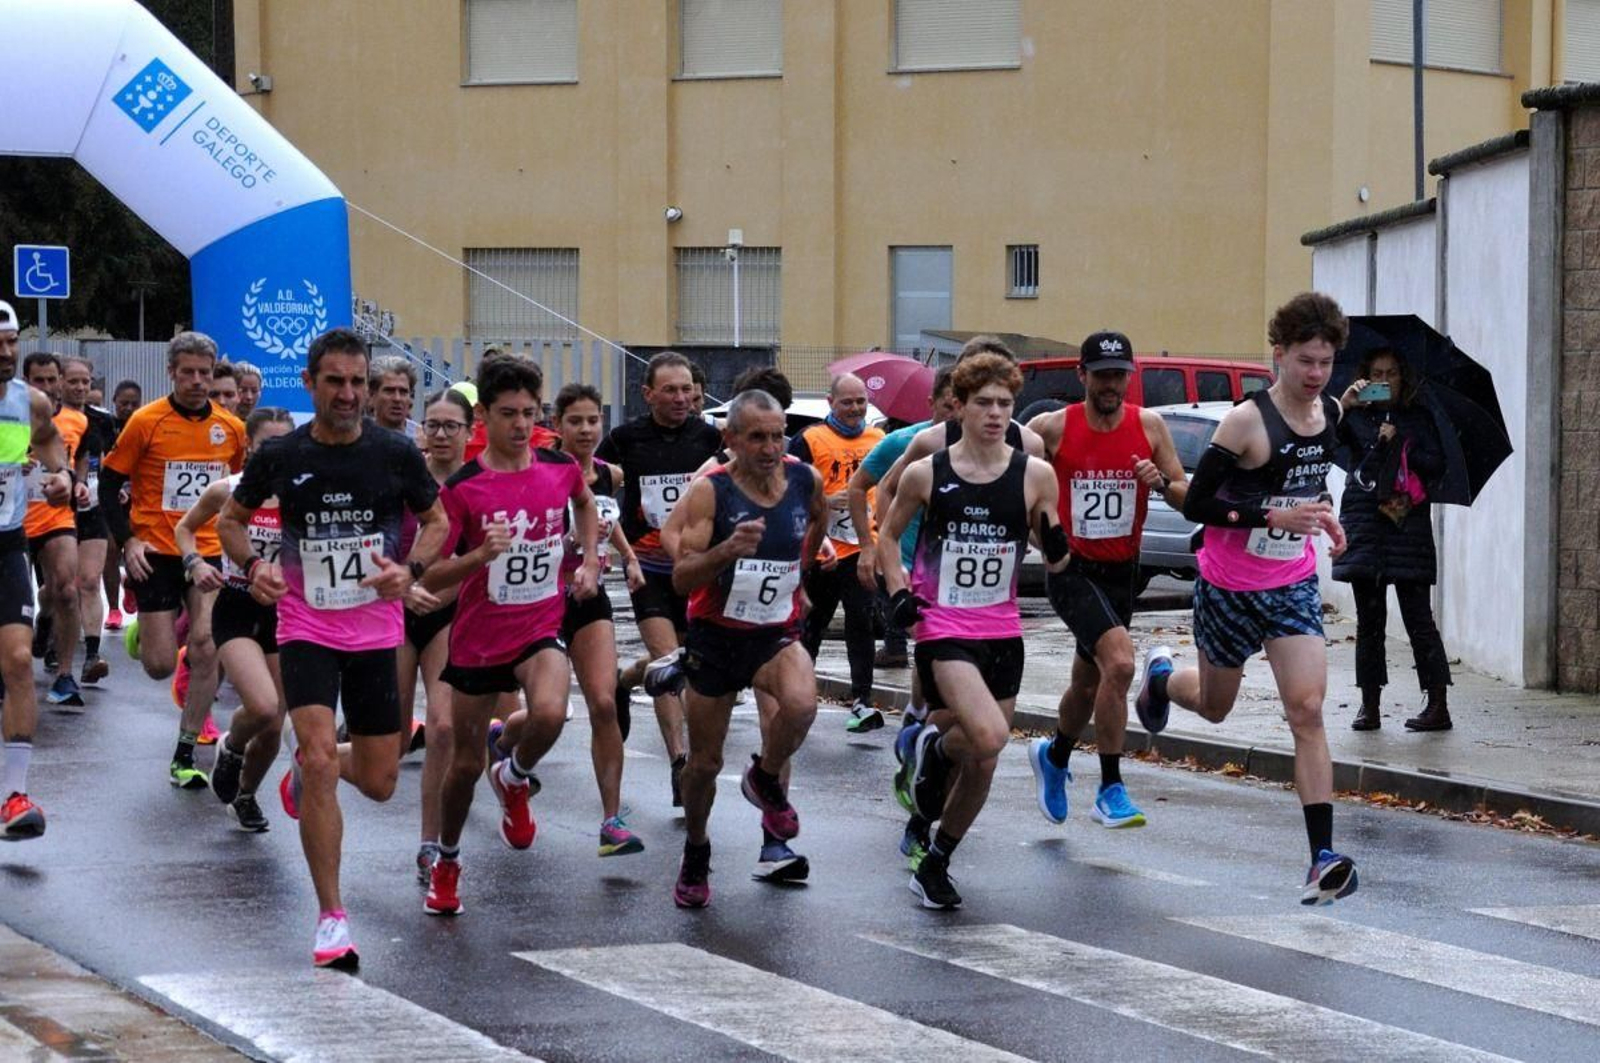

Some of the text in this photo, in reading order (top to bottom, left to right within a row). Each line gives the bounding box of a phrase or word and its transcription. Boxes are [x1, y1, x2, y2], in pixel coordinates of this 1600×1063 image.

[205, 116, 277, 183] DEPORTE
[192, 130, 256, 189] GALEGO
[258, 302, 314, 316] VALDEORRAS
[261, 377, 304, 389] ALDEOR
[169, 462, 183, 471] La
[1074, 469, 1133, 479] O BARCO
[1286, 461, 1333, 480] O BARCO
[177, 472, 210, 497] 23
[641, 477, 657, 486] La
[1073, 480, 1089, 490] La
[1084, 492, 1122, 520] 20
[305, 509, 374, 524] O BARCO
[257, 527, 282, 540] Reg
[947, 521, 1007, 537] O BARCO
[302, 540, 323, 553] La
[946, 541, 964, 554] La
[321, 552, 367, 589] 14
[505, 551, 551, 586] 85
[738, 560, 758, 572] La
[955, 556, 1003, 589] 88
[758, 576, 781, 606] 6
